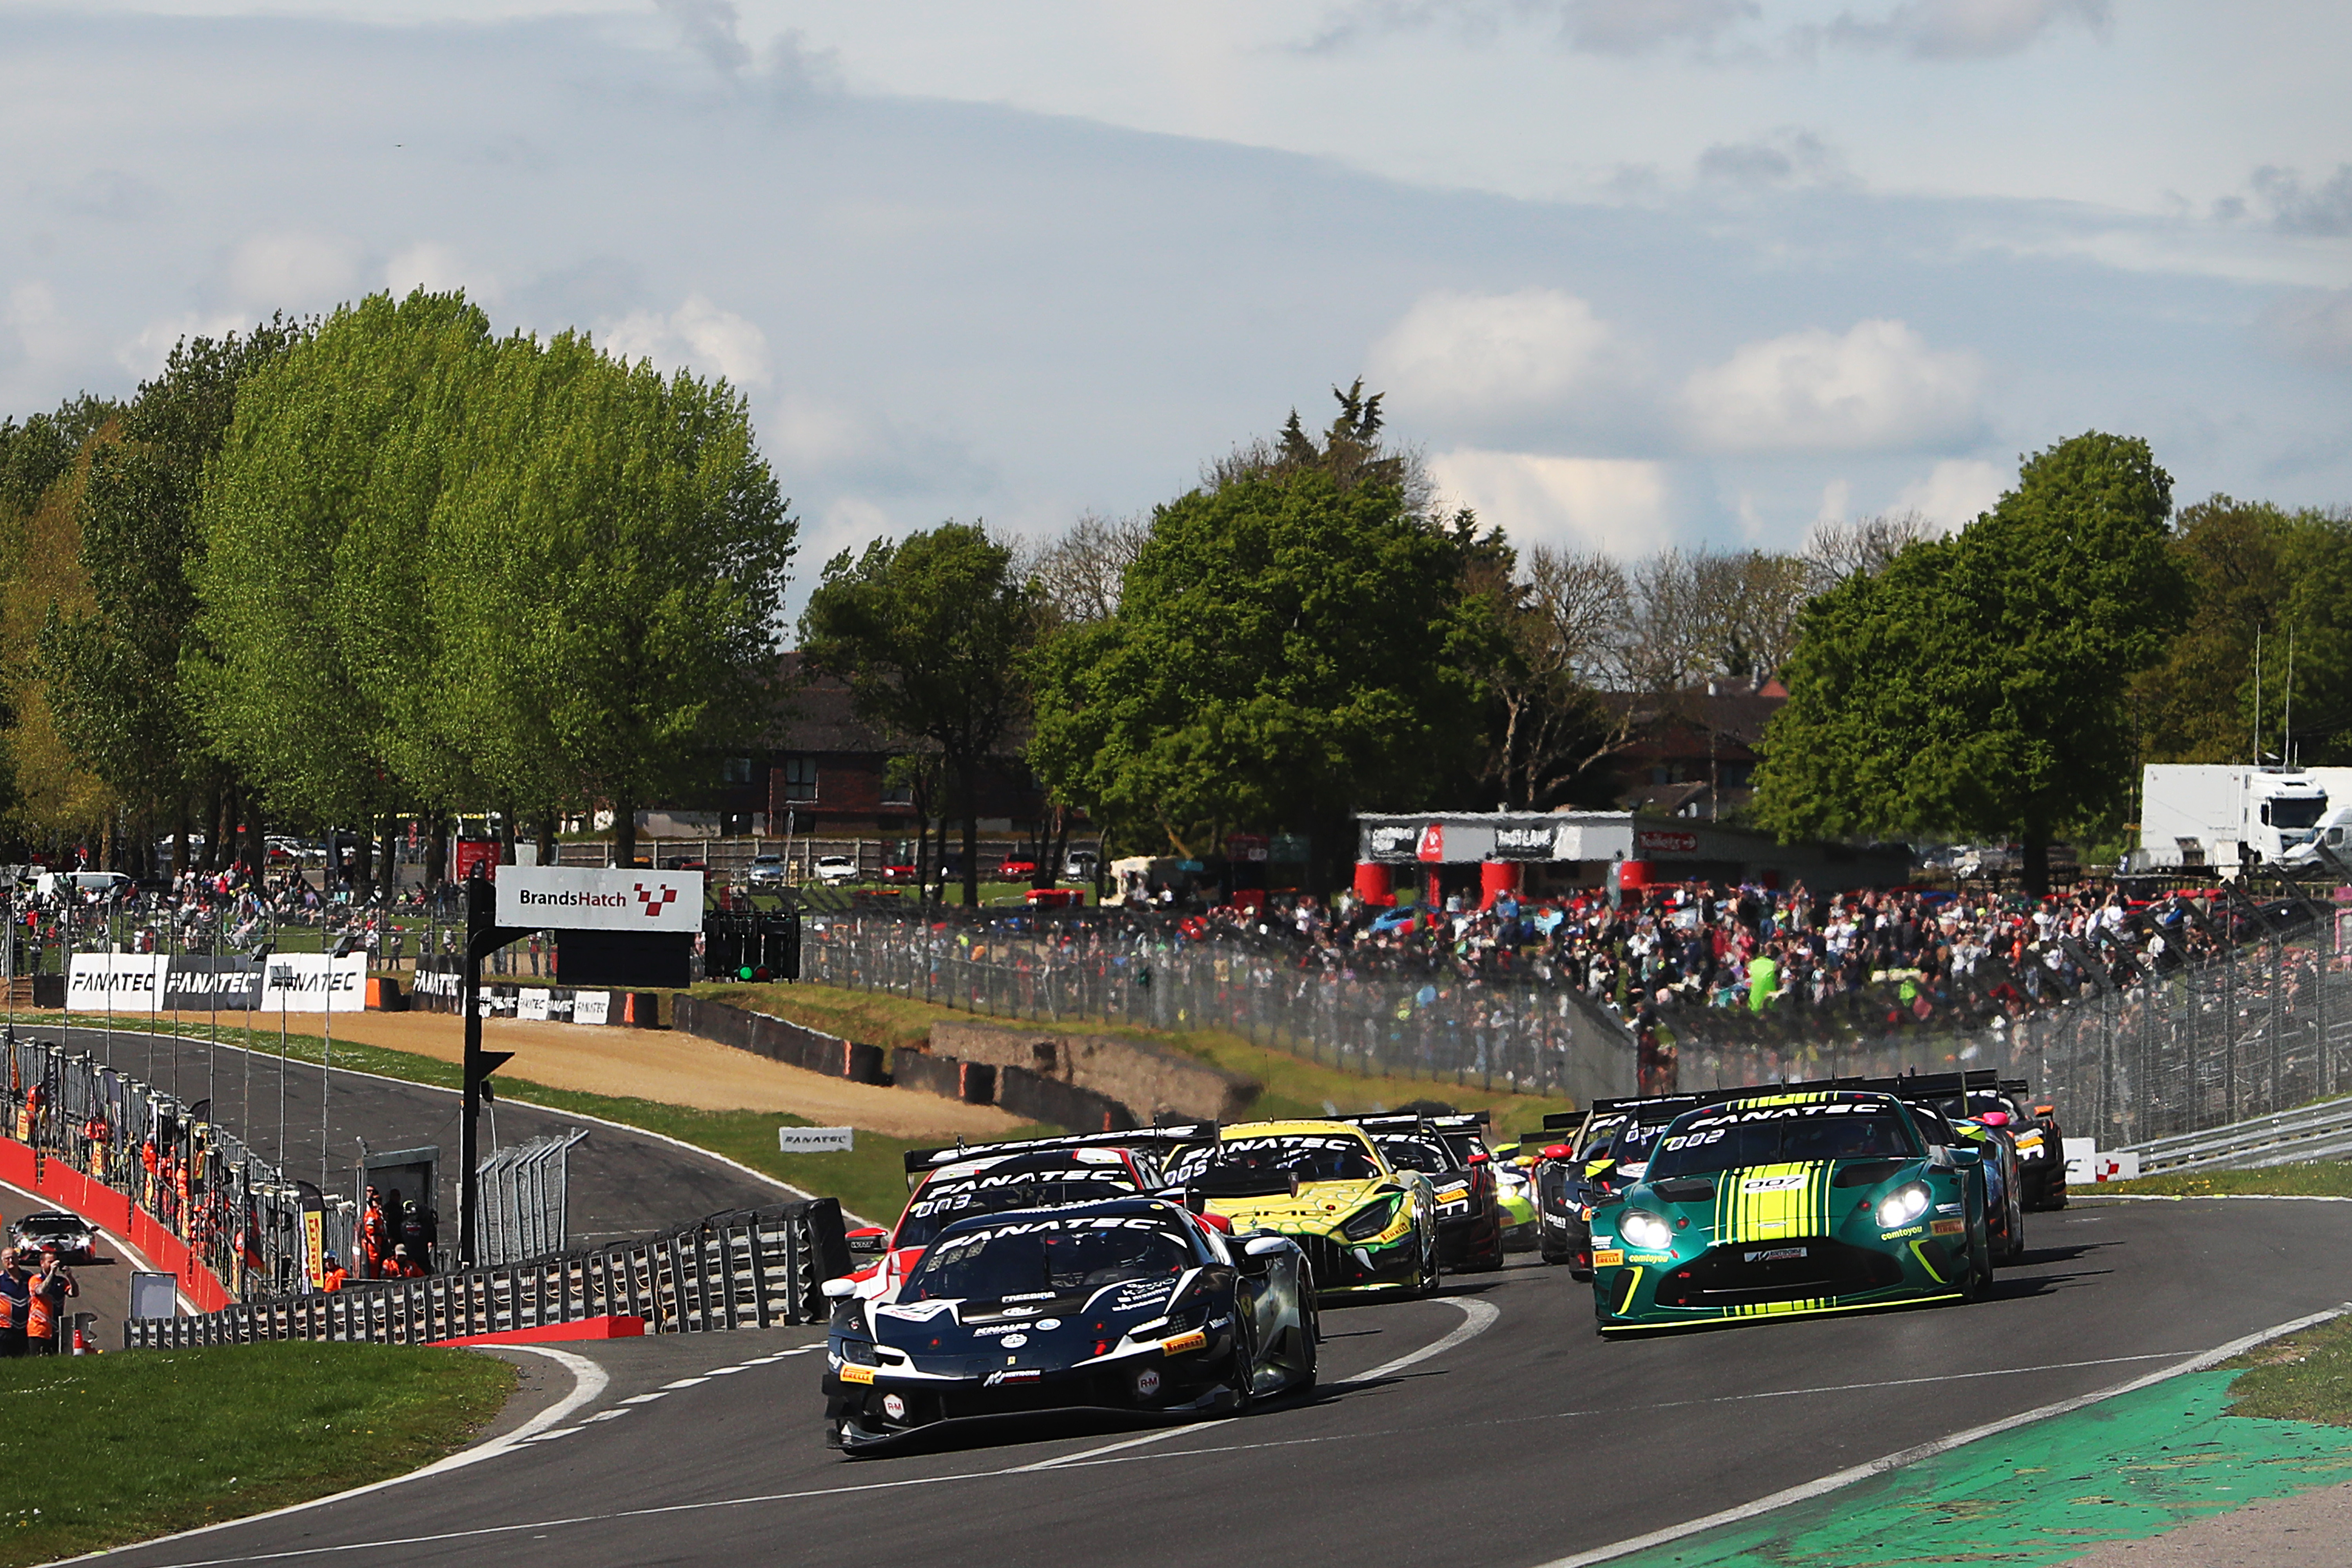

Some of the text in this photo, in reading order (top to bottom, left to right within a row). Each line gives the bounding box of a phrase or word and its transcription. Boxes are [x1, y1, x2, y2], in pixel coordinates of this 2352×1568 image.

[520, 889, 626, 907] BrandsHatch
[73, 973, 155, 991] FANATEC
[166, 972, 257, 993] FANATEC
[268, 972, 357, 992] NATEC
[1687, 1104, 1880, 1131] FANATEC
[785, 1135, 846, 1144] FANATEC
[1666, 1129, 1725, 1151] 002
[1181, 1137, 1351, 1166] FANATEC
[927, 1169, 1120, 1200] FANATEC
[1744, 1177, 1802, 1189] 007
[935, 1218, 1158, 1255] FANATEC
[1380, 1222, 1409, 1241] PIRELLI
[1881, 1226, 1922, 1241] comtoyou
[1595, 1253, 1619, 1263] PIRELLI
[1629, 1254, 1670, 1264] comtoyou
[974, 1323, 1031, 1335] KNAUS
[1166, 1335, 1203, 1352] PIRELLI
[842, 1368, 871, 1381] PIRELLI
[1140, 1376, 1158, 1388] R-M
